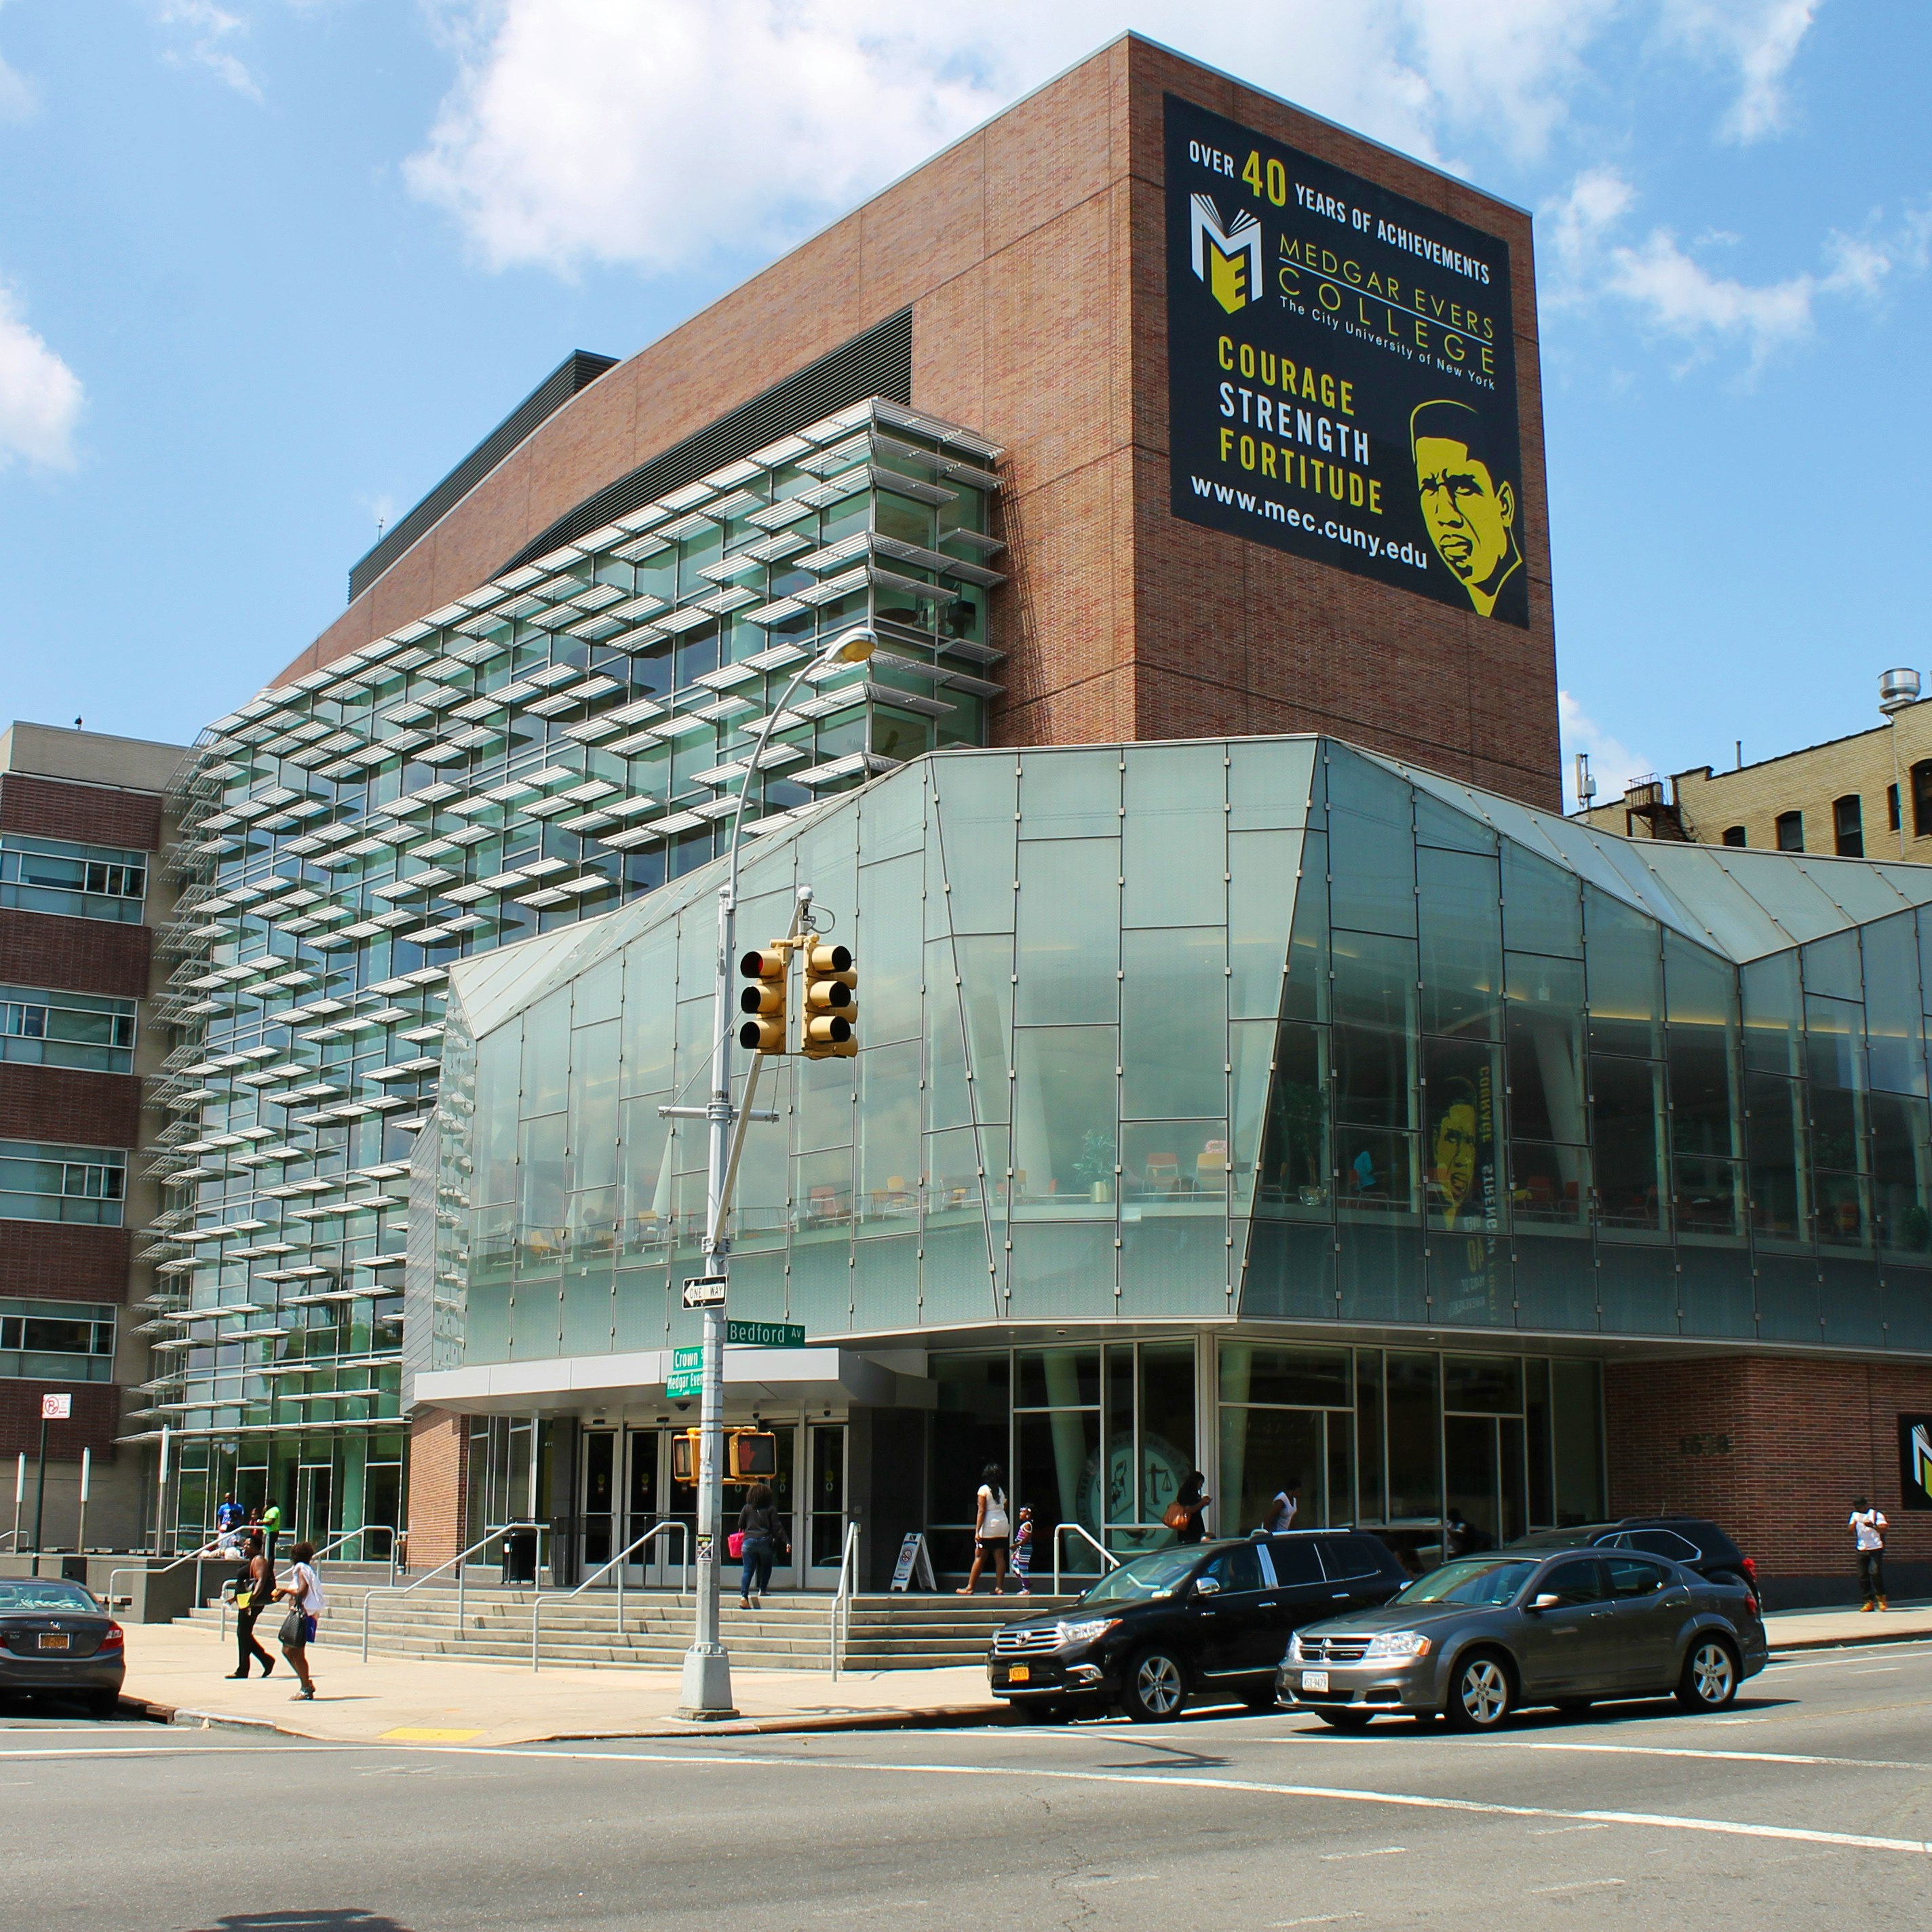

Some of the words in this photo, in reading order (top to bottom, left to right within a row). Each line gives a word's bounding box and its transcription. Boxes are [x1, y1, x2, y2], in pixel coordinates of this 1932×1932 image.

[1189, 140, 1234, 178] OVER
[1242, 150, 1286, 206] 40
[1295, 182, 1346, 223] YEARS
[1352, 208, 1372, 233] OF
[1377, 219, 1490, 284] ACHIEVEMENTS
[1279, 233, 1399, 301] MEDGAR
[1415, 288, 1493, 339] EVERS
[1279, 267, 1494, 374] COLLEGE
[1218, 336, 1354, 416] COURAGE
[1279, 295, 1305, 315] The
[1312, 309, 1338, 330] City
[1345, 321, 1413, 360] University
[1418, 353, 1431, 365] of
[1437, 358, 1463, 377] New
[1467, 370, 1494, 390] York
[1220, 382, 1369, 465] STRENGTH
[1220, 427, 1383, 515] FORTITUDE
[1191, 475, 1427, 569] www.mec.cuny.edu
[689, 1288, 702, 1299] ONE
[710, 1286, 722, 1297] WAY
[730, 1324, 785, 1343] Bedford
[791, 1328, 801, 1338] Av
[668, 1374, 689, 1393] Medgar
[690, 1373, 703, 1387] Ever
[675, 1351, 698, 1368] Crown
